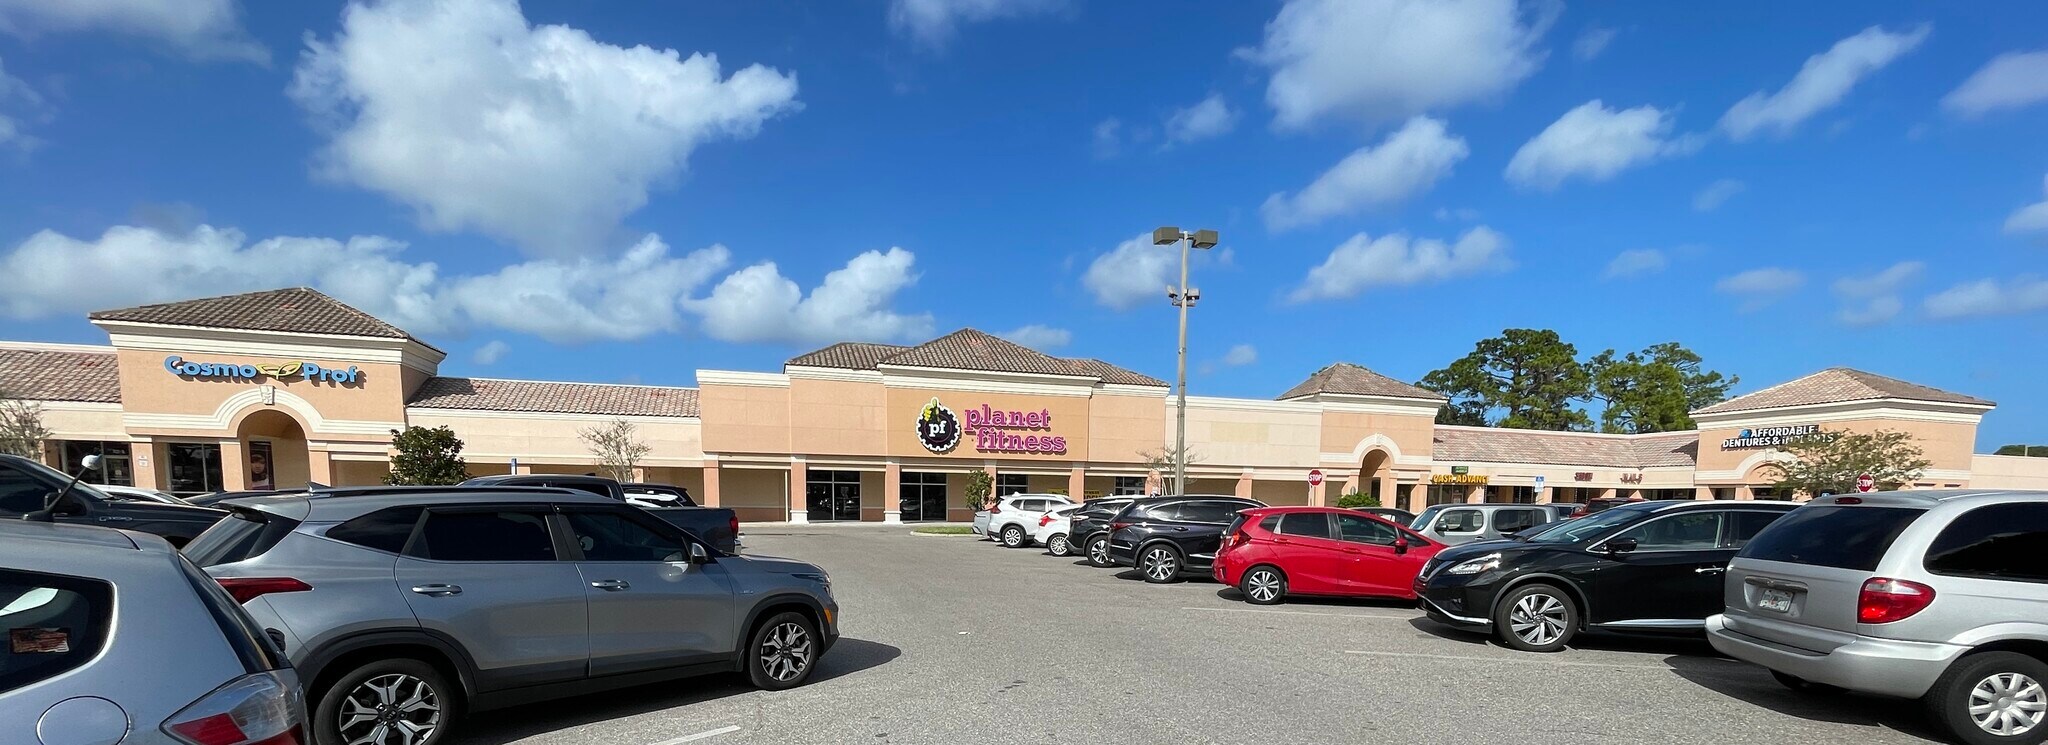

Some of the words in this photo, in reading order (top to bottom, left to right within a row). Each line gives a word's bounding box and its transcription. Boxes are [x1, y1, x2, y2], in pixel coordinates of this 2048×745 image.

[164, 355, 257, 378] Cosmo
[303, 362, 358, 383] Prof
[965, 404, 1049, 431] planet
[929, 420, 947, 437] pf
[1751, 425, 1815, 438] AFFORDABLE
[976, 428, 1066, 451] fitness
[1722, 437, 1770, 448] DENTURES
[1772, 436, 1780, 445] &
[1433, 474, 1454, 483] CASH
[1859, 479, 1873, 487] STOP
